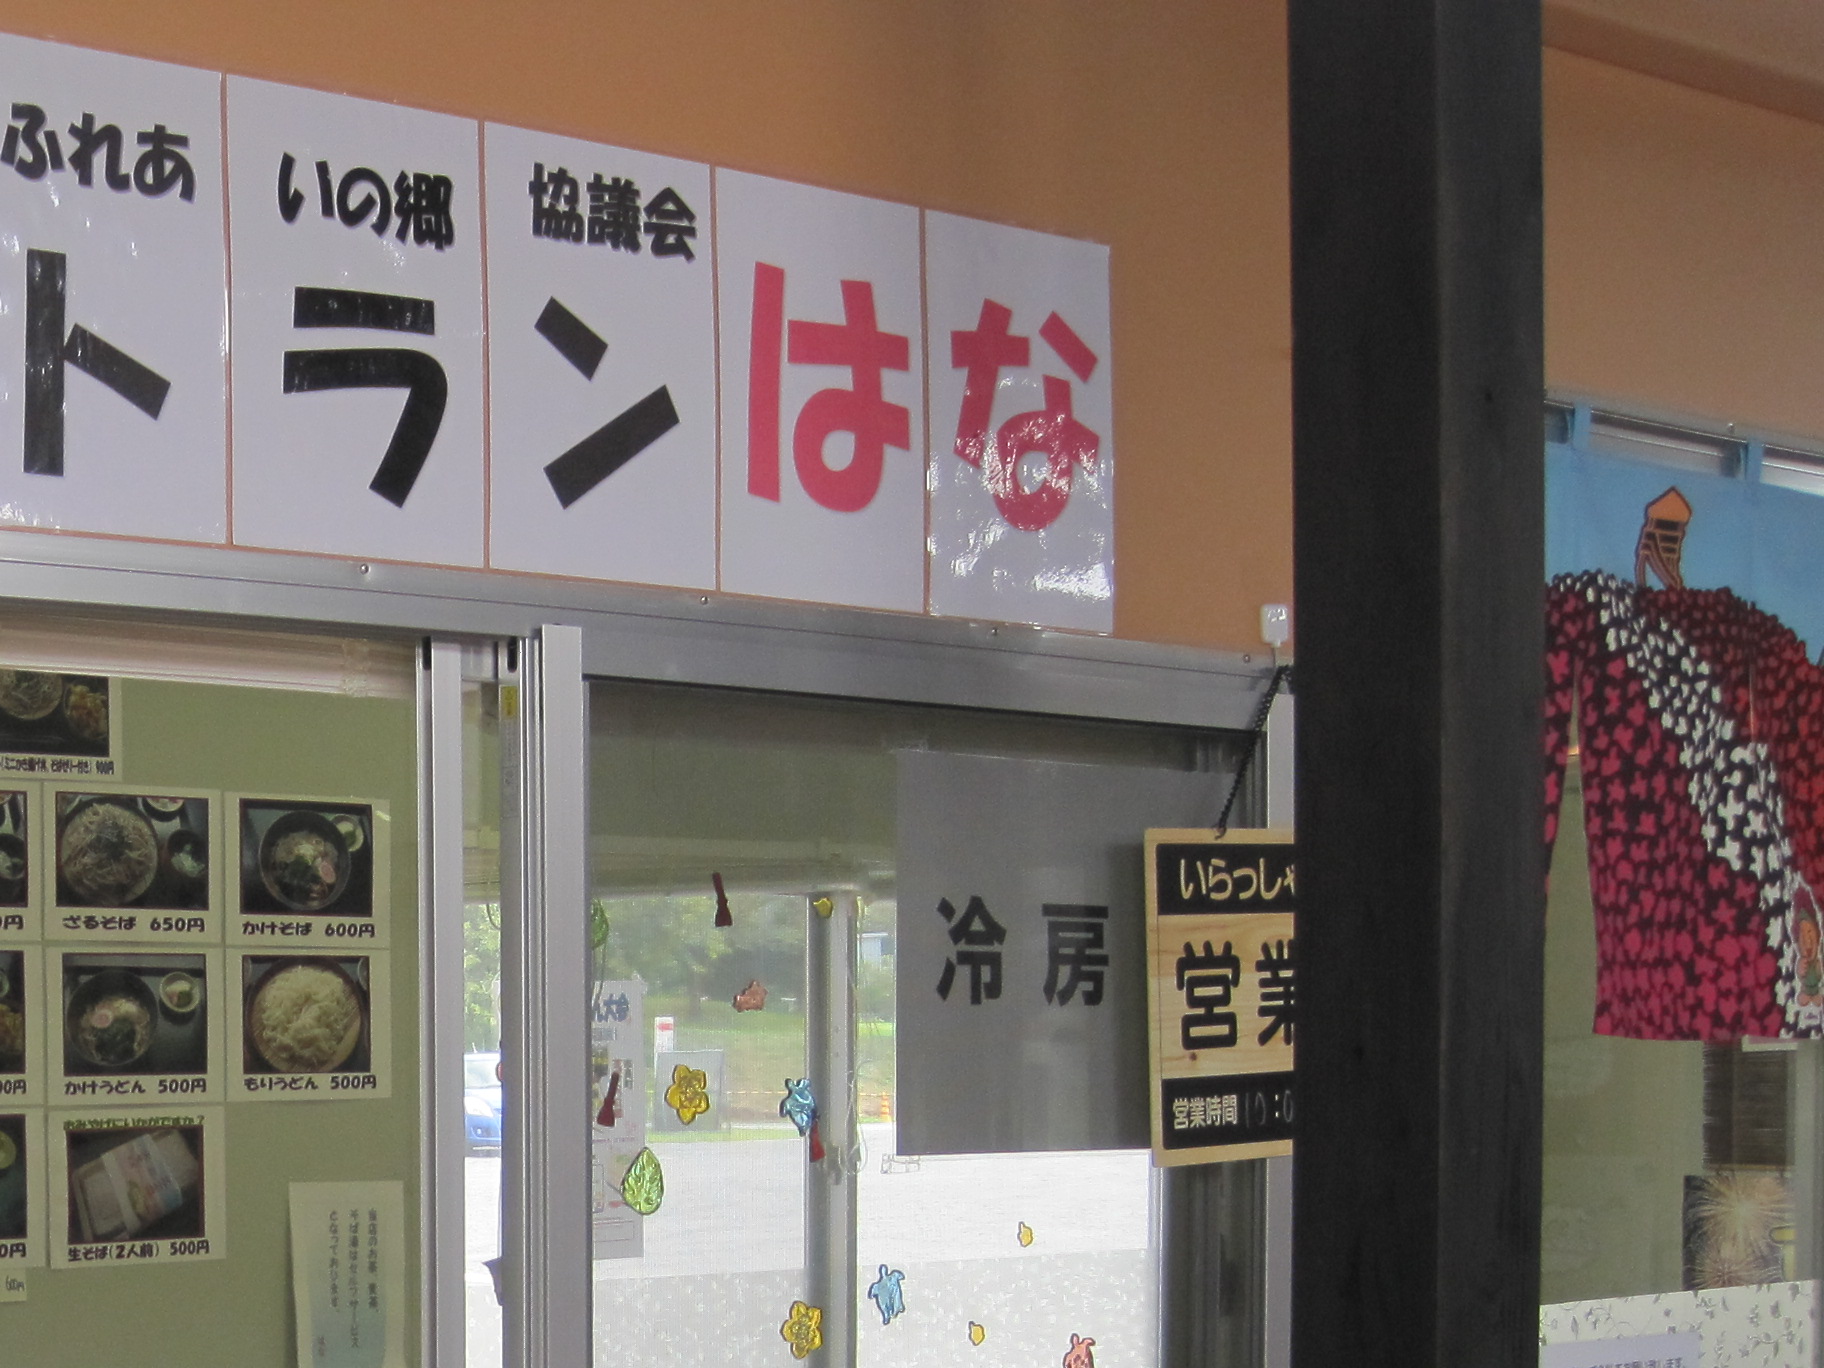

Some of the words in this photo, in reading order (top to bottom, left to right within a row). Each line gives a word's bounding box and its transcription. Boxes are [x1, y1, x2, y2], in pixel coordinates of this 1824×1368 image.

[0, 101, 197, 203] ふれあ
[277, 152, 455, 252] いの郷
[528, 162, 697, 262] 協議会
[747, 261, 1101, 532] はな
[62, 915, 138, 931] ざるそば
[149, 916, 206, 933] 650円
[241, 921, 313, 937] かけそば
[324, 923, 376, 939] 600円
[935, 895, 1111, 1008] 冷房
[64, 1079, 146, 1096] かけうどん
[157, 1077, 207, 1094] 500円
[243, 1076, 318, 1092] もりうどん
[329, 1074, 377, 1091] 500円
[1172, 1093, 1238, 1131] 営業時間
[169, 1239, 210, 1256] 500円
